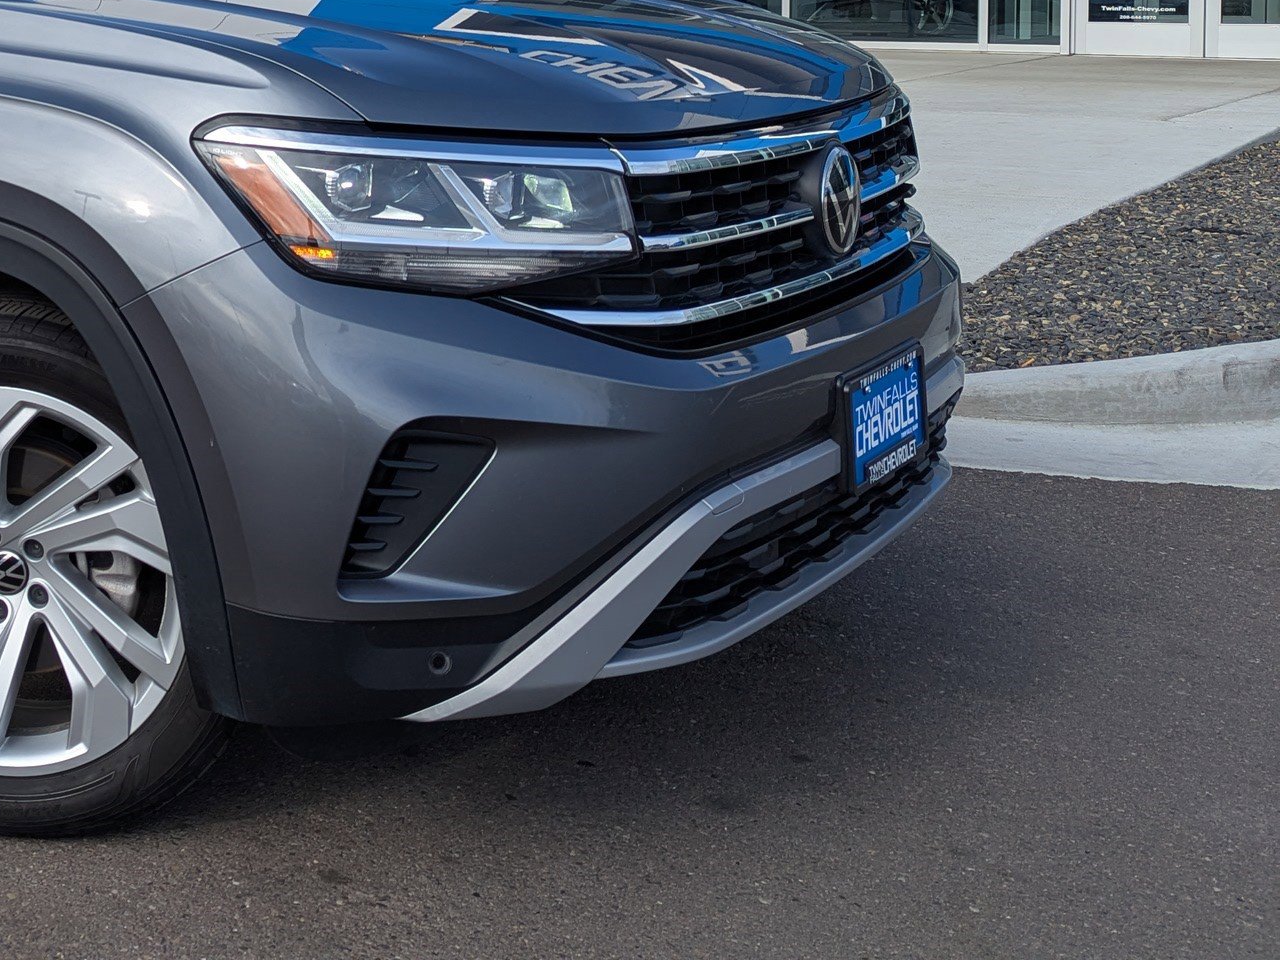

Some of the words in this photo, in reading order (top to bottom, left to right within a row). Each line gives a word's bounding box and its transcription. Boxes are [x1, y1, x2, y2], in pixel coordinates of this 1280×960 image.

[1101, 5, 1176, 13] TwinFalls-Chevy.com
[855, 372, 918, 424] TWINFALLS
[856, 389, 919, 458] CHEVROLET
[883, 439, 917, 474] CHEVROLET
